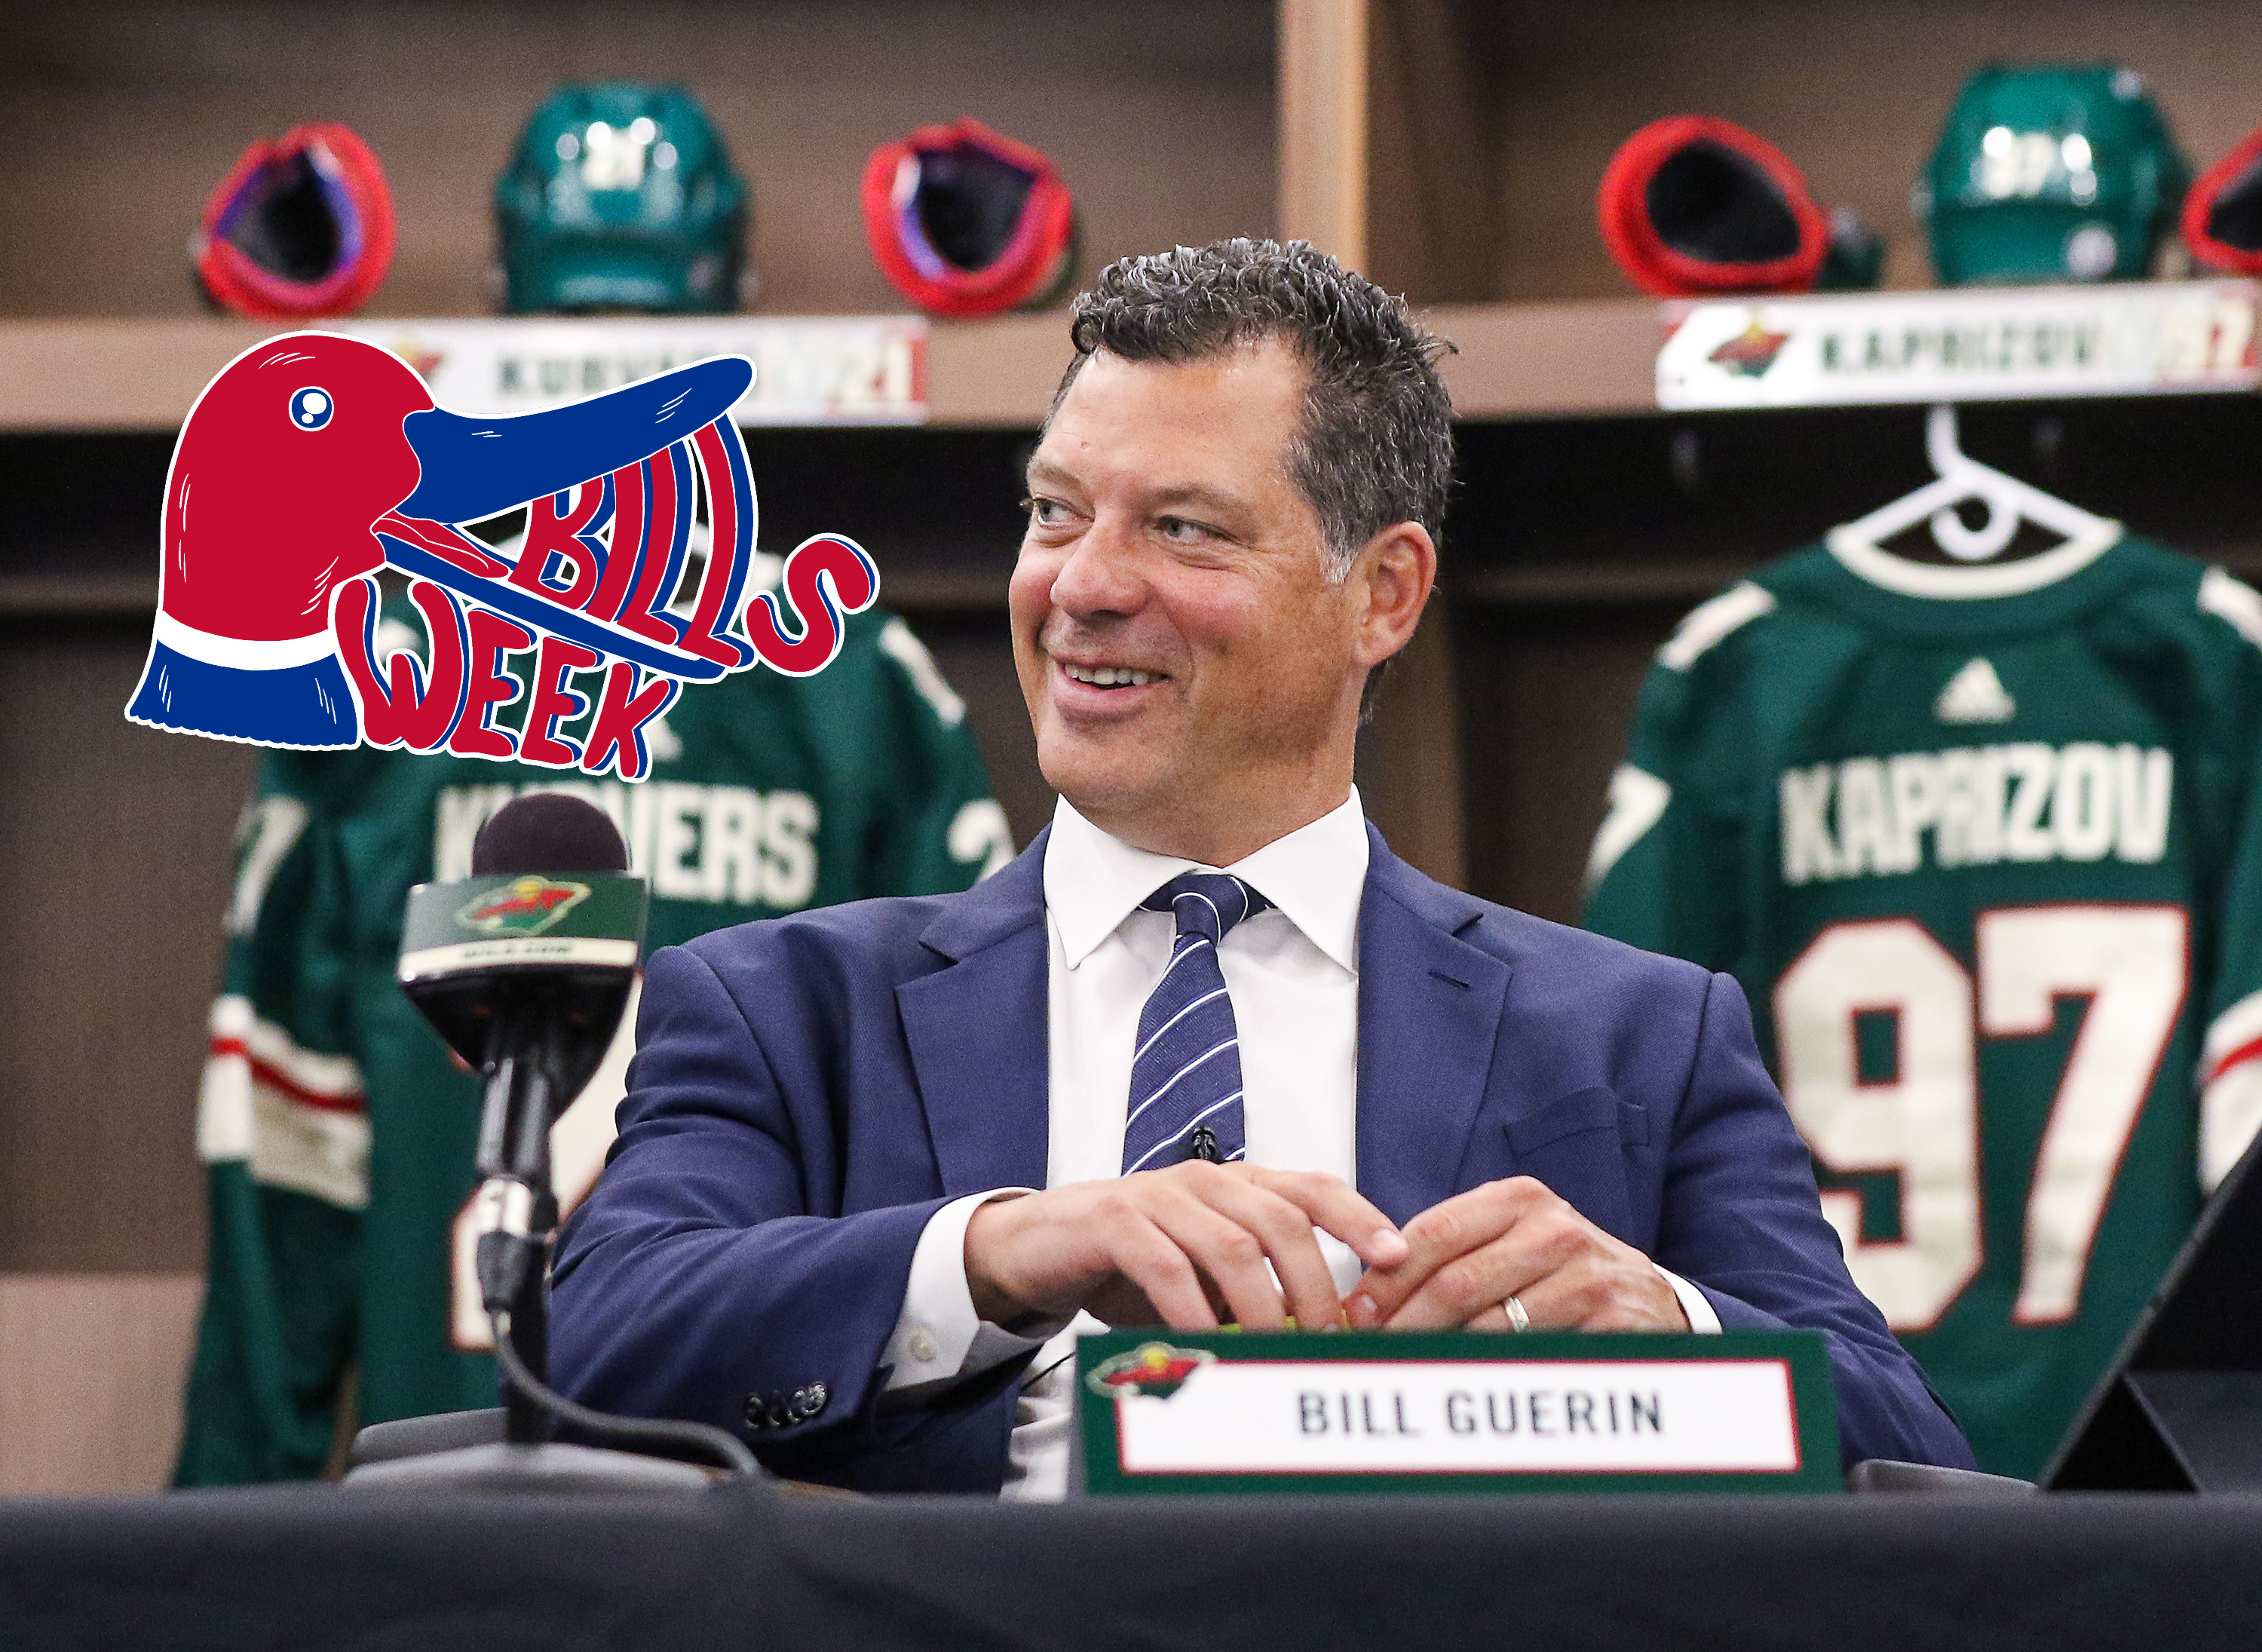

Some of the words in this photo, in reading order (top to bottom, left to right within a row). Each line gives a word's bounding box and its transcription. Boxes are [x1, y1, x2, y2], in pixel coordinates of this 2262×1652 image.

[1779, 741, 2174, 885] KAPRIZOV
[1772, 903, 2190, 1332] 97
[1297, 1390, 1421, 1436] BILL
[1445, 1390, 1664, 1436] GUERIN
